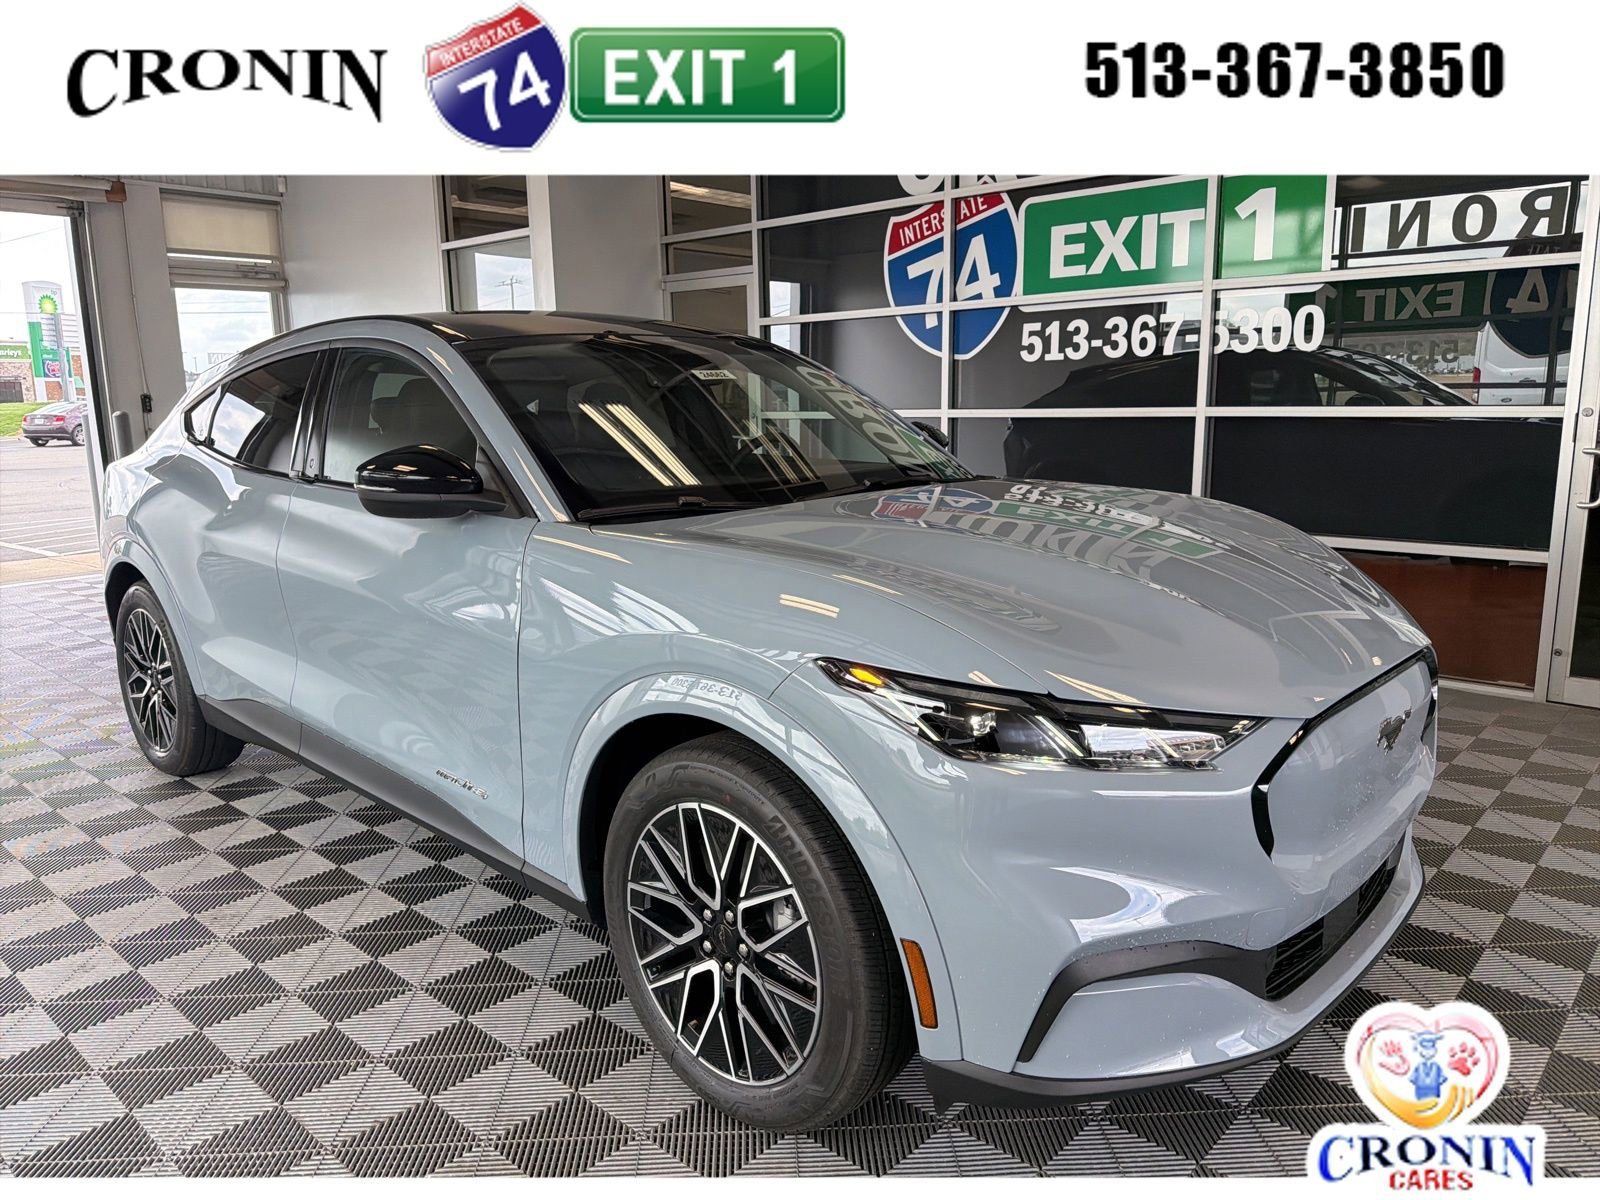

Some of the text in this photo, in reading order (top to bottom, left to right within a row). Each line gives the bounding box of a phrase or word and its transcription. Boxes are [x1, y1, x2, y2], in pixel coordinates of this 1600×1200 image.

[899, 195, 988, 246] INTERSATE
[1049, 186, 1277, 280] EXIT 1
[906, 233, 1001, 329] 74
[1019, 305, 1326, 362] 513-367-5300
